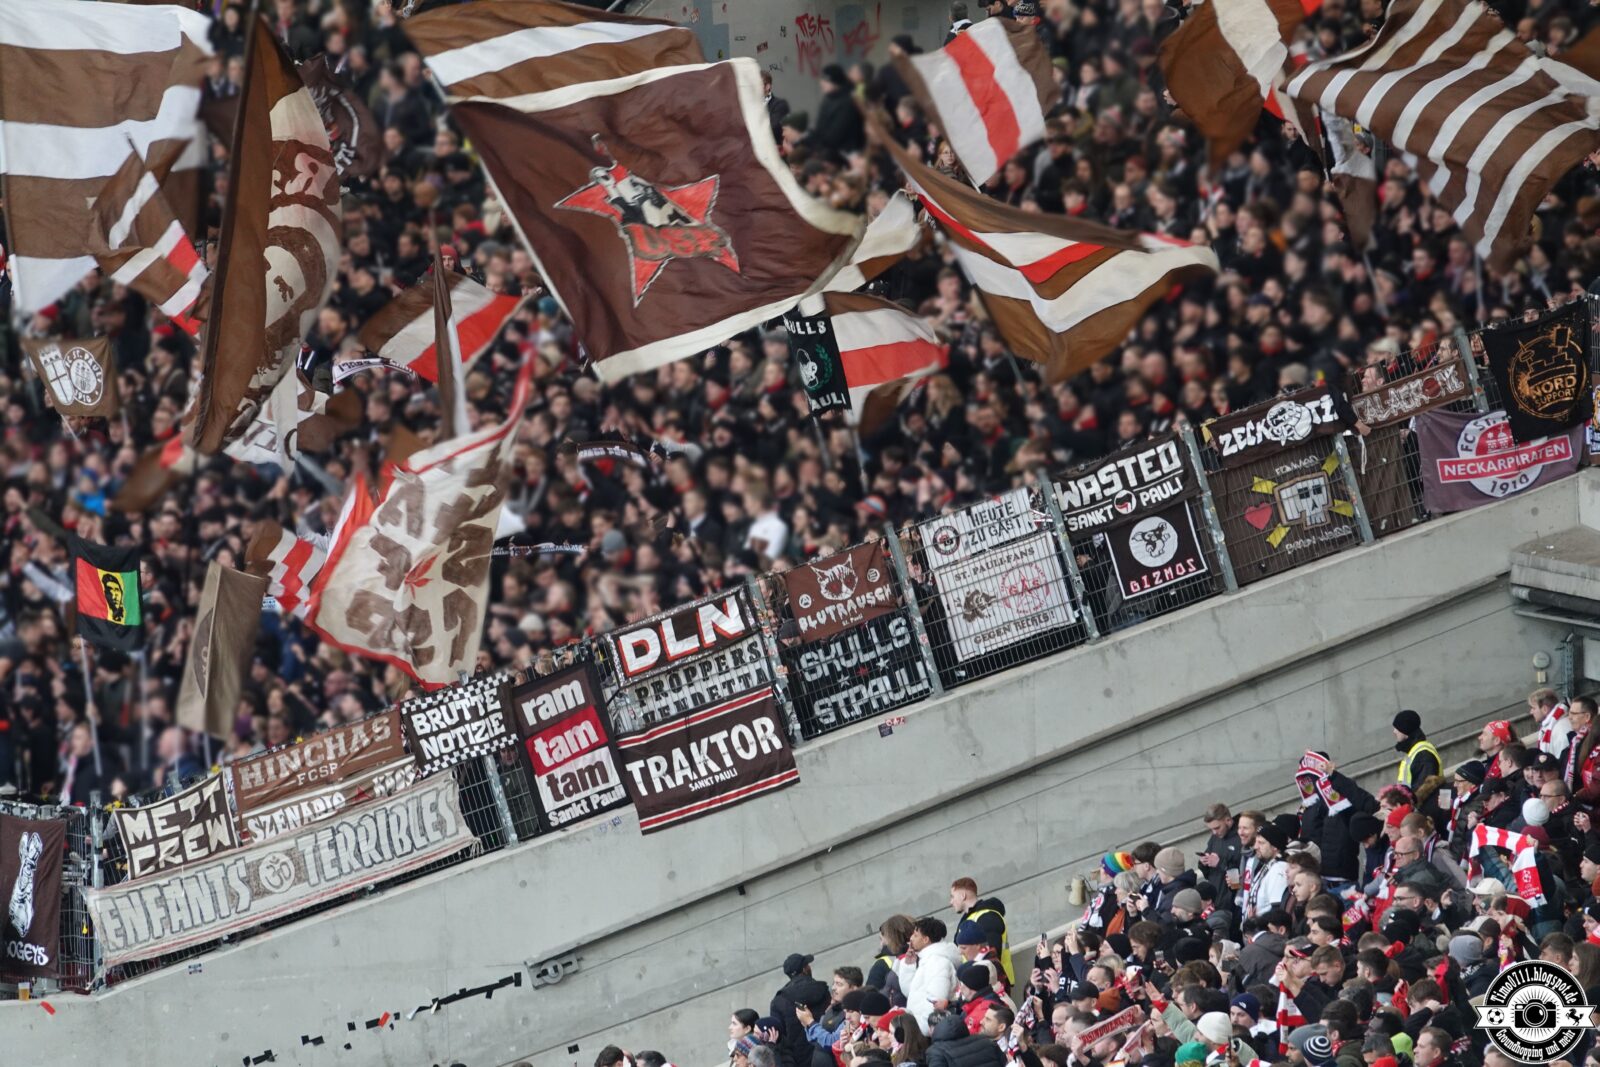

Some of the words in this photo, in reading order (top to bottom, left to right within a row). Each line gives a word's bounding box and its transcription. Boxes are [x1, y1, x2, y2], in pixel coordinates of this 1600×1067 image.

[809, 391, 847, 411] AULI
[1531, 376, 1577, 397] NORD
[1535, 388, 1576, 408] SUPPORT
[1444, 442, 1566, 476] NECKARPIRATEN
[1461, 432, 1476, 452] FC
[1052, 440, 1183, 511] WASTED
[1490, 474, 1530, 494] 1910
[970, 502, 1015, 528] HEUTE
[1067, 503, 1115, 532] SANKT
[1140, 479, 1184, 507] PAULI
[968, 530, 986, 546] ZU
[1130, 558, 1197, 593] GIZMOS
[798, 584, 892, 632] BLUTRAUSCH
[618, 596, 746, 678] DLN
[800, 616, 911, 682] SKULLS
[973, 624, 1011, 644] GEGEN
[635, 641, 762, 706] PROPPERS
[411, 687, 501, 735] BRUTTE
[521, 679, 586, 726] ram
[238, 716, 391, 790] HINCHAS
[419, 713, 506, 760] NOTIZIE
[534, 719, 599, 767] tam
[626, 716, 783, 797] TRAKTOR
[297, 762, 338, 785] FCSP
[546, 758, 610, 801] tam
[689, 776, 713, 792] SANKT
[714, 768, 738, 786] PAULI
[123, 777, 222, 845] METT
[548, 799, 588, 827] Sankt
[589, 784, 626, 811] Pauli
[101, 857, 252, 952] ENFANTS
[304, 784, 458, 887] TERRIBLES
[130, 815, 234, 878] CREW
[5, 940, 49, 966] OGEYS
